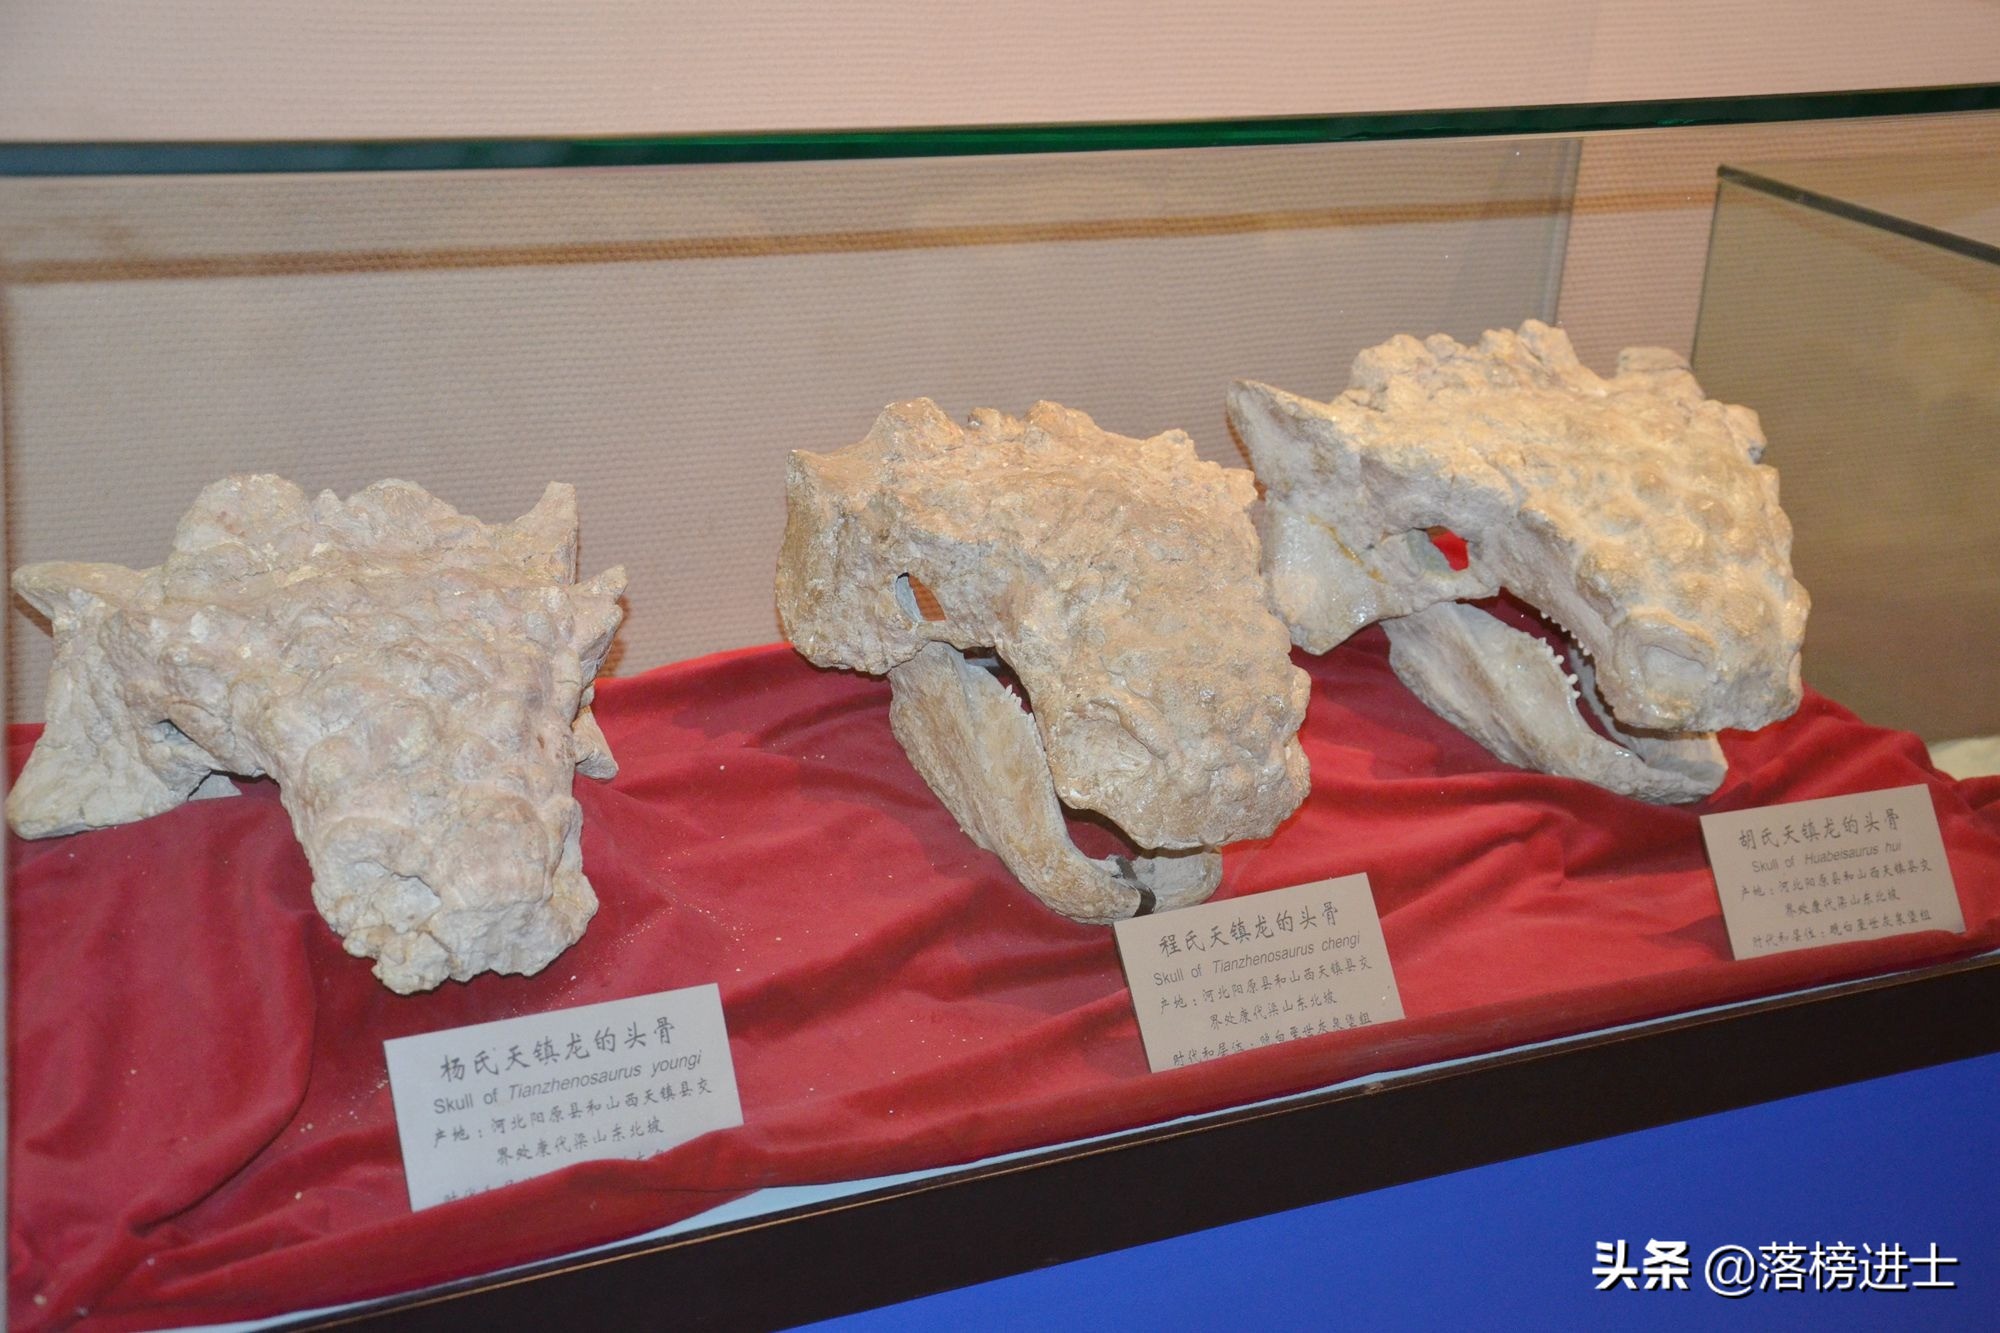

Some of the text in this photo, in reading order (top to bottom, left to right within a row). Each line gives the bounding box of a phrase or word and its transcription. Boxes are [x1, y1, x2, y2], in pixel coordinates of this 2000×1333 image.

[1739, 808, 1900, 850] 胡氏天镇龙的头骨
[1752, 842, 1901, 873] Skull of Huabeisaurus hui
[1159, 901, 1339, 958] 程氏天镇龙的头骨
[1153, 931, 1361, 986] Skull of Tianzhenosaurus chengi
[440, 1016, 675, 1082] 杨氏天镇龙的头骨
[433, 1050, 702, 1114] Skull of Tianzhenosaurus youngi
